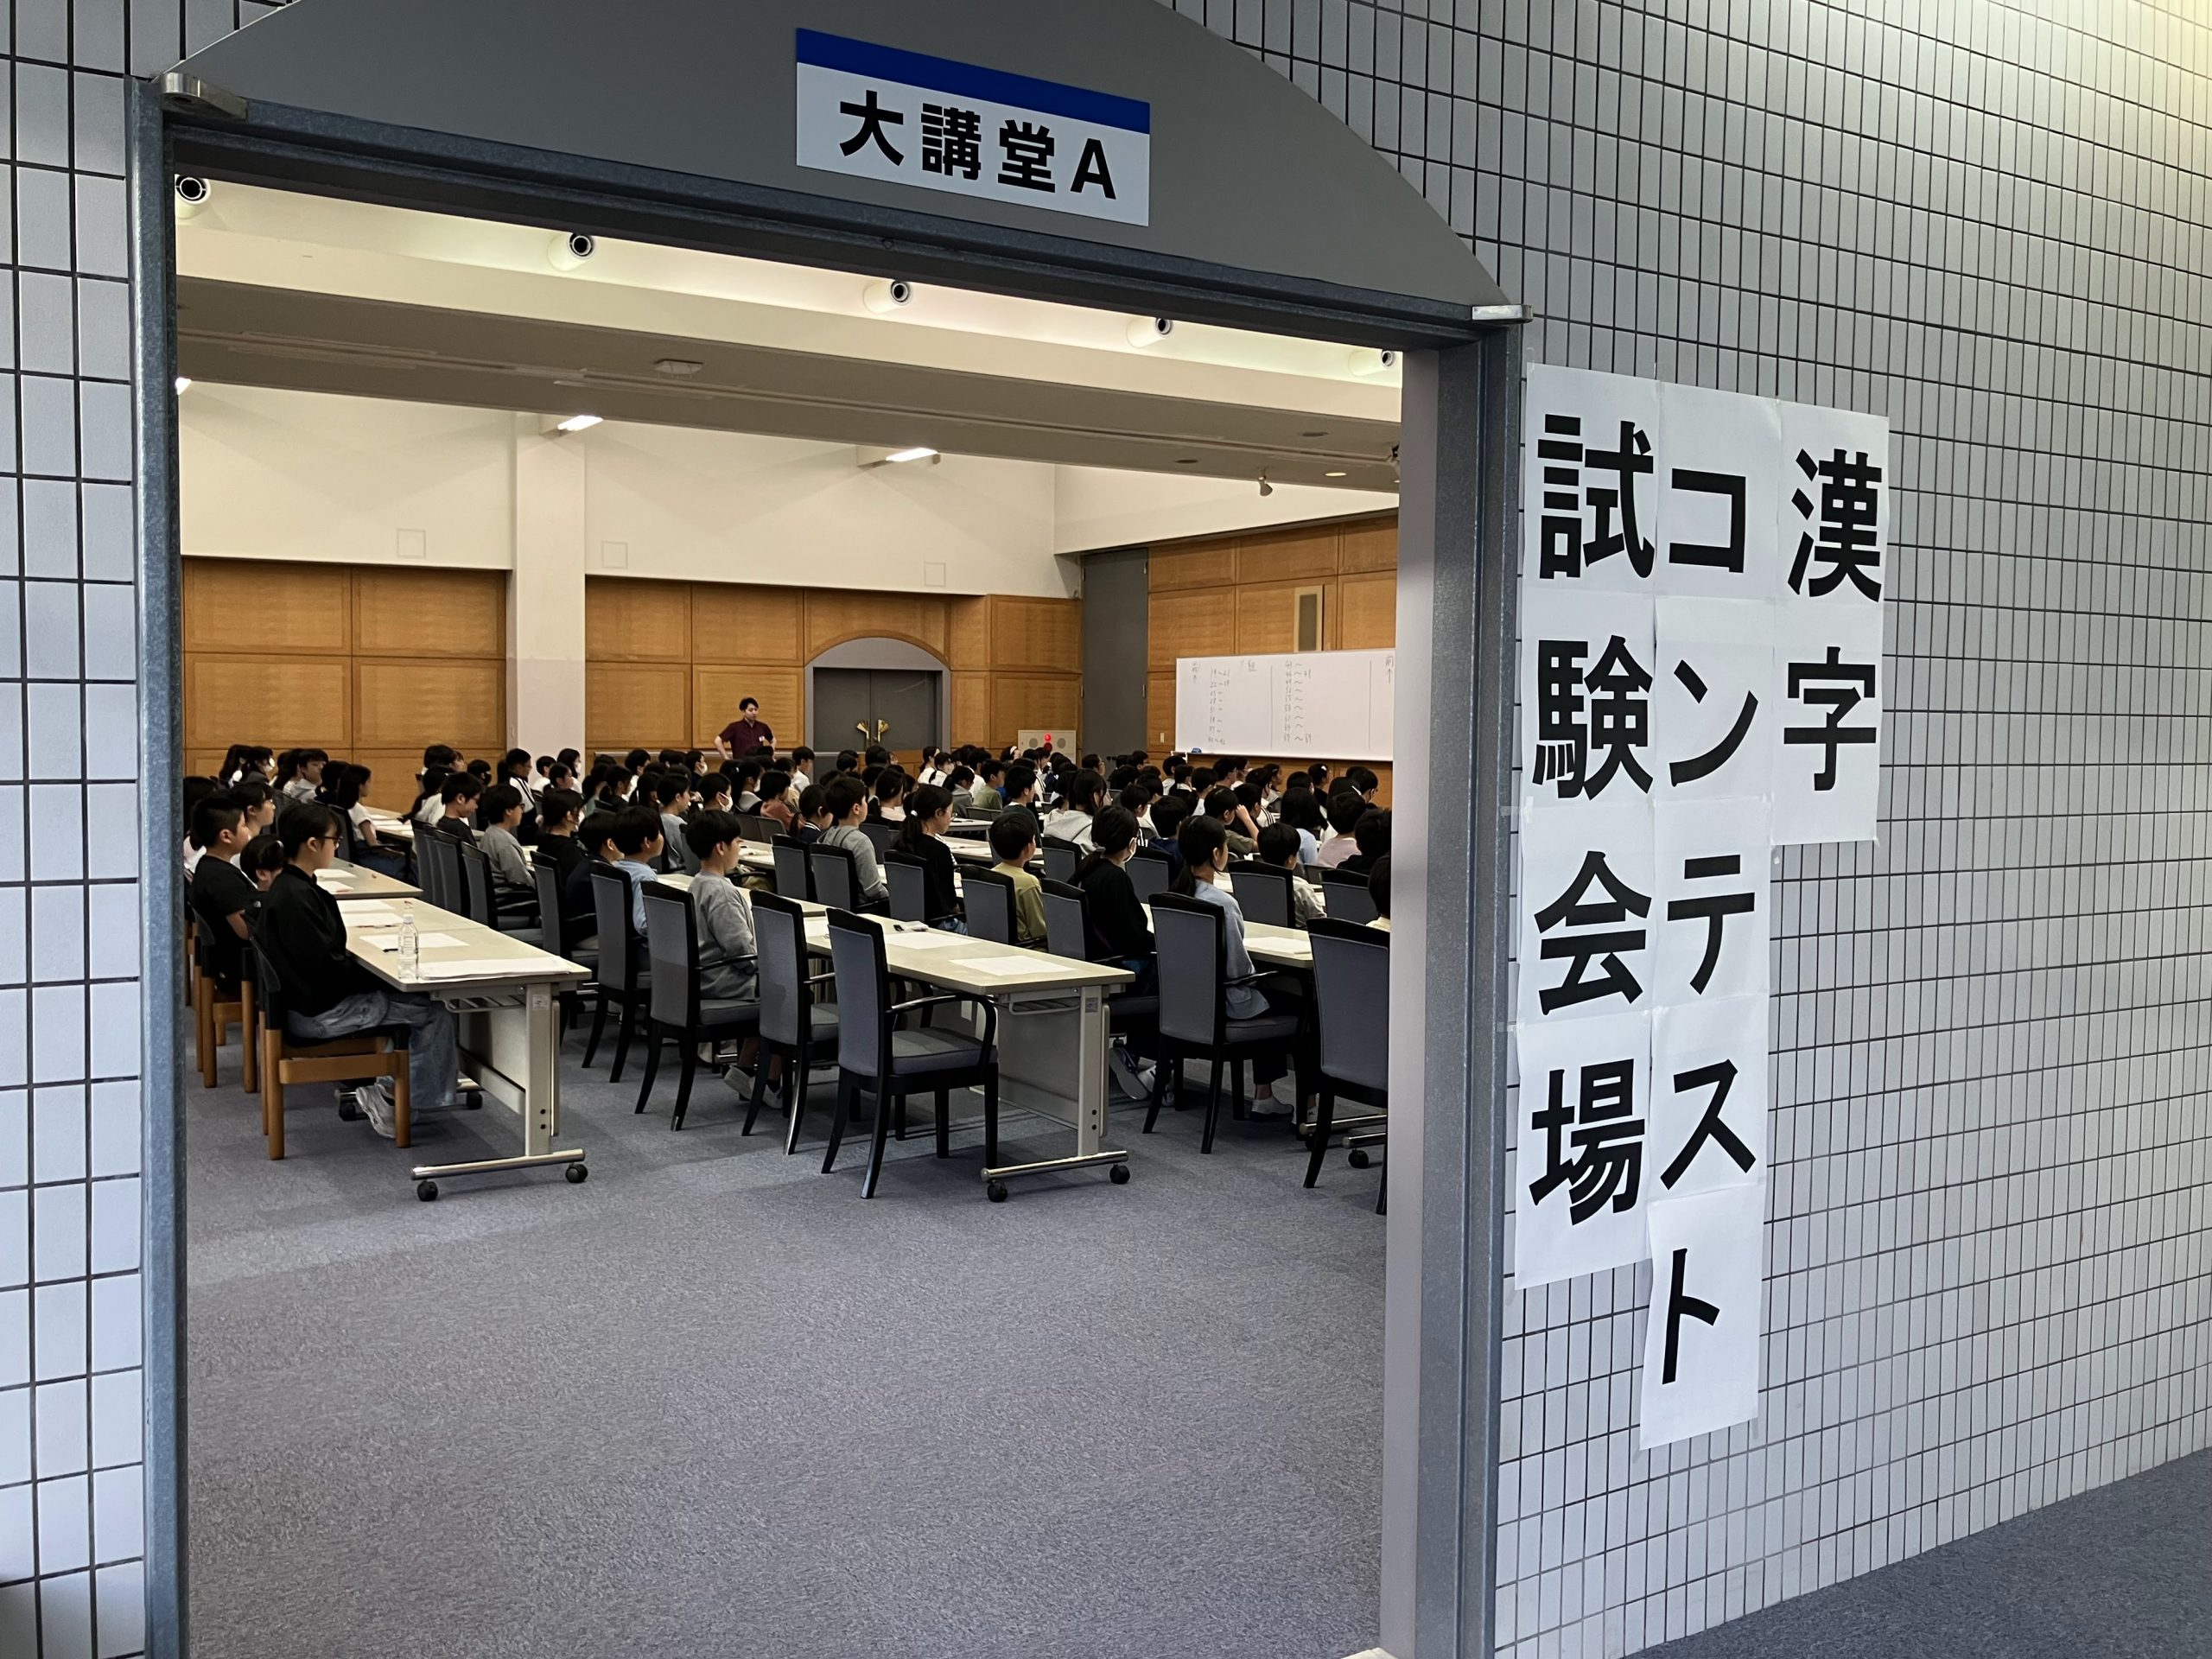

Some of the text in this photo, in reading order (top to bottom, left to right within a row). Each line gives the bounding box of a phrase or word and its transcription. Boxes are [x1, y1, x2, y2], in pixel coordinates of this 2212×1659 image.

[839, 89, 1117, 200] 大講堂A
[1529, 413, 1655, 1226] 試験会場
[1784, 448, 1883, 791] 漢字
[1660, 467, 1758, 1386] コンテスト
